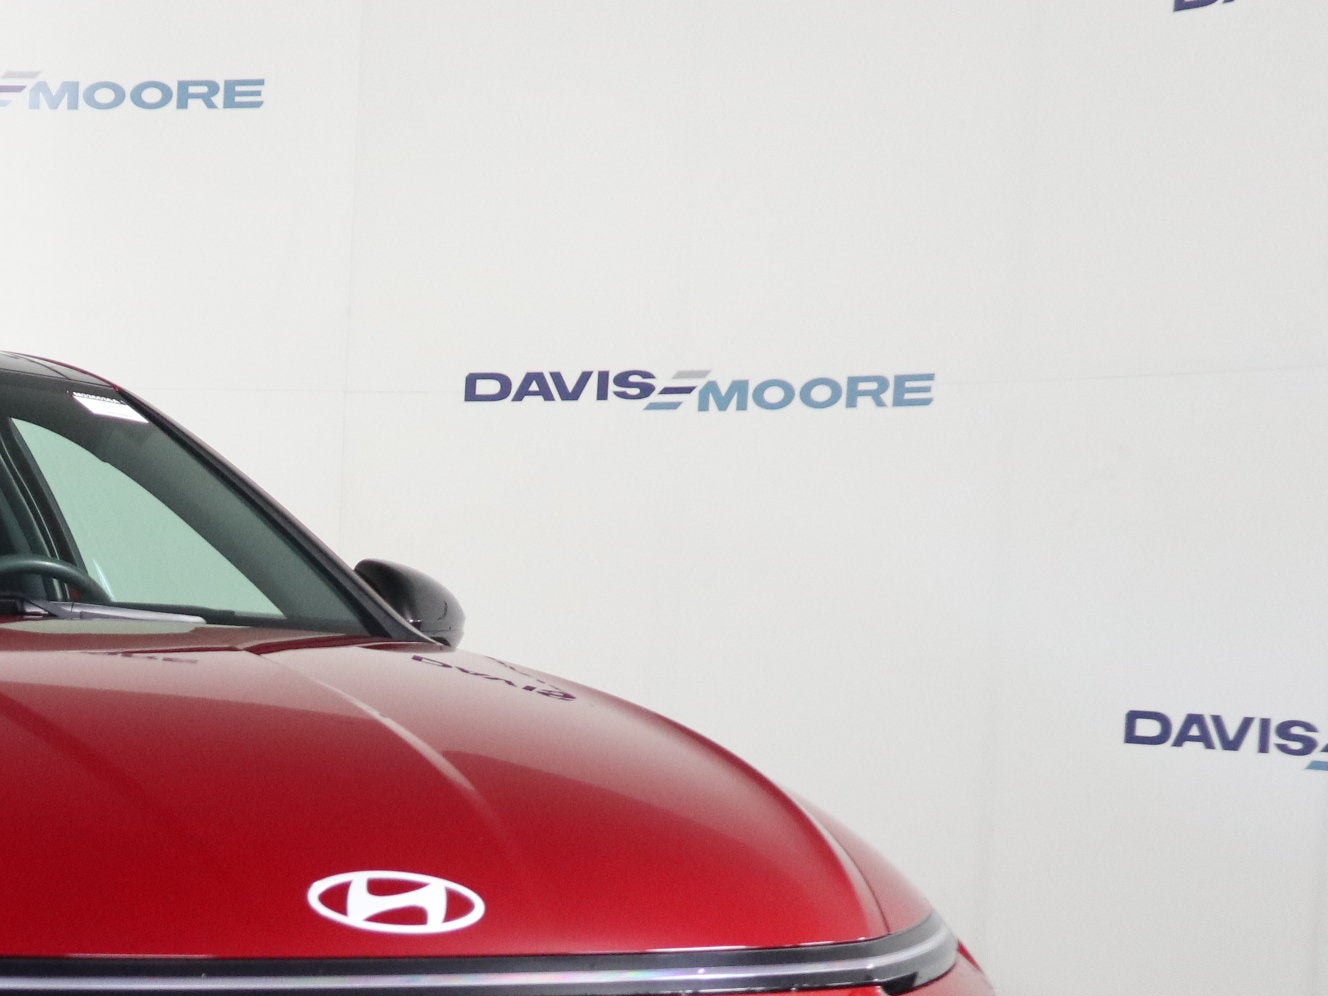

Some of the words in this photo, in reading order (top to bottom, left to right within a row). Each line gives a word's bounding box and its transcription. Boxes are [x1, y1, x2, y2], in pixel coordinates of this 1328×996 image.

[27, 78, 265, 111] MOORE
[464, 370, 657, 402] DAVIS
[696, 373, 936, 412] MOORE
[1124, 710, 1319, 757] DAVIS
